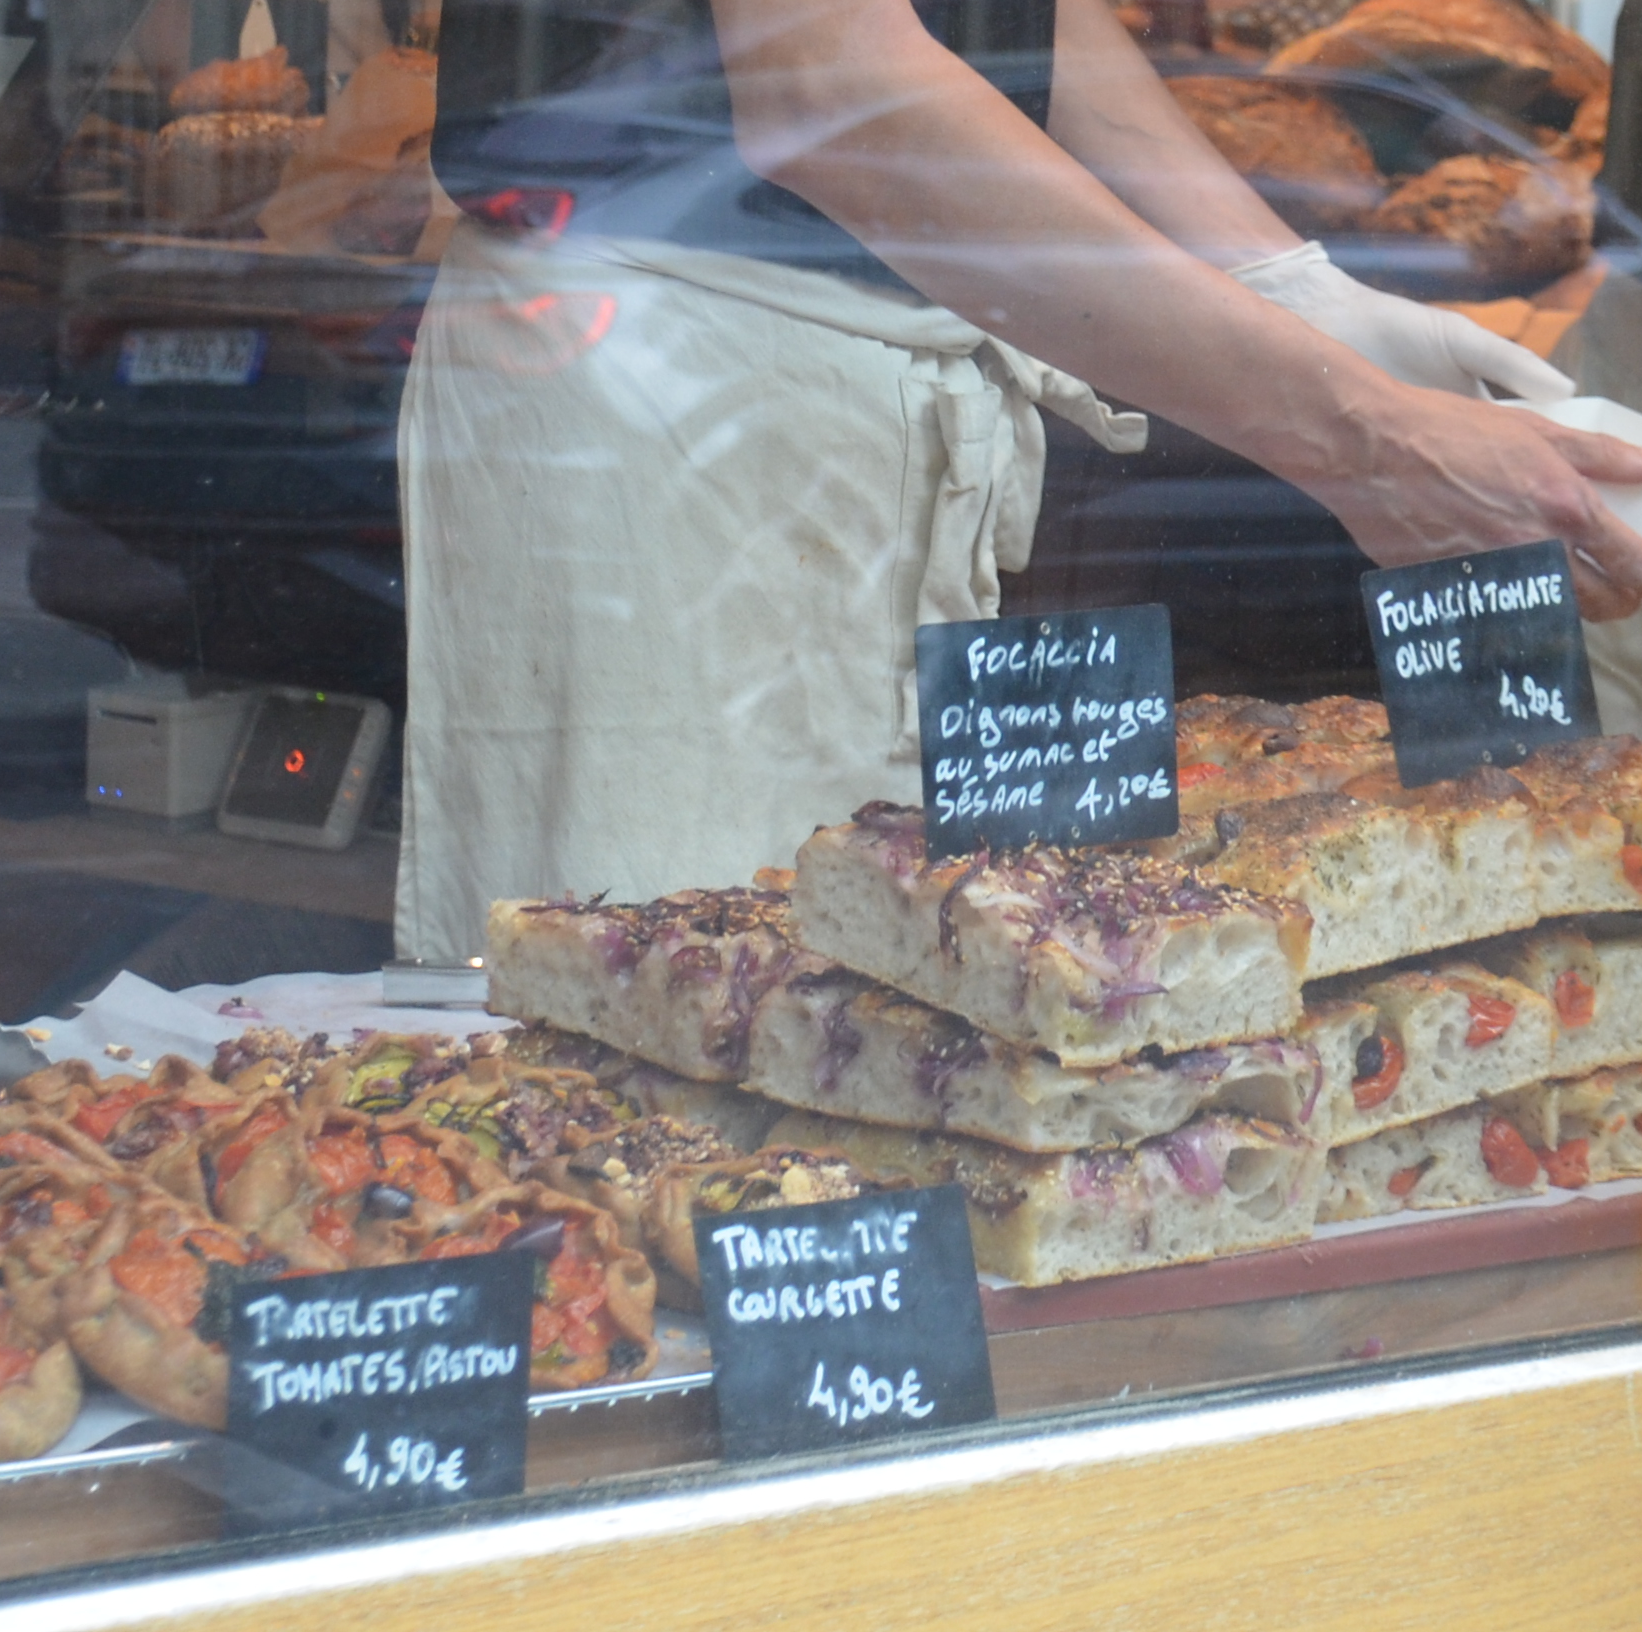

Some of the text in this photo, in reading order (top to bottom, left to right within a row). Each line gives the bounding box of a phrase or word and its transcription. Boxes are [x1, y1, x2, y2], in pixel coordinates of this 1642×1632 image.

[1083, 729, 1118, 763] et
[807, 1361, 935, 1427] 4,90€
[343, 1431, 468, 1492] 4,90€
